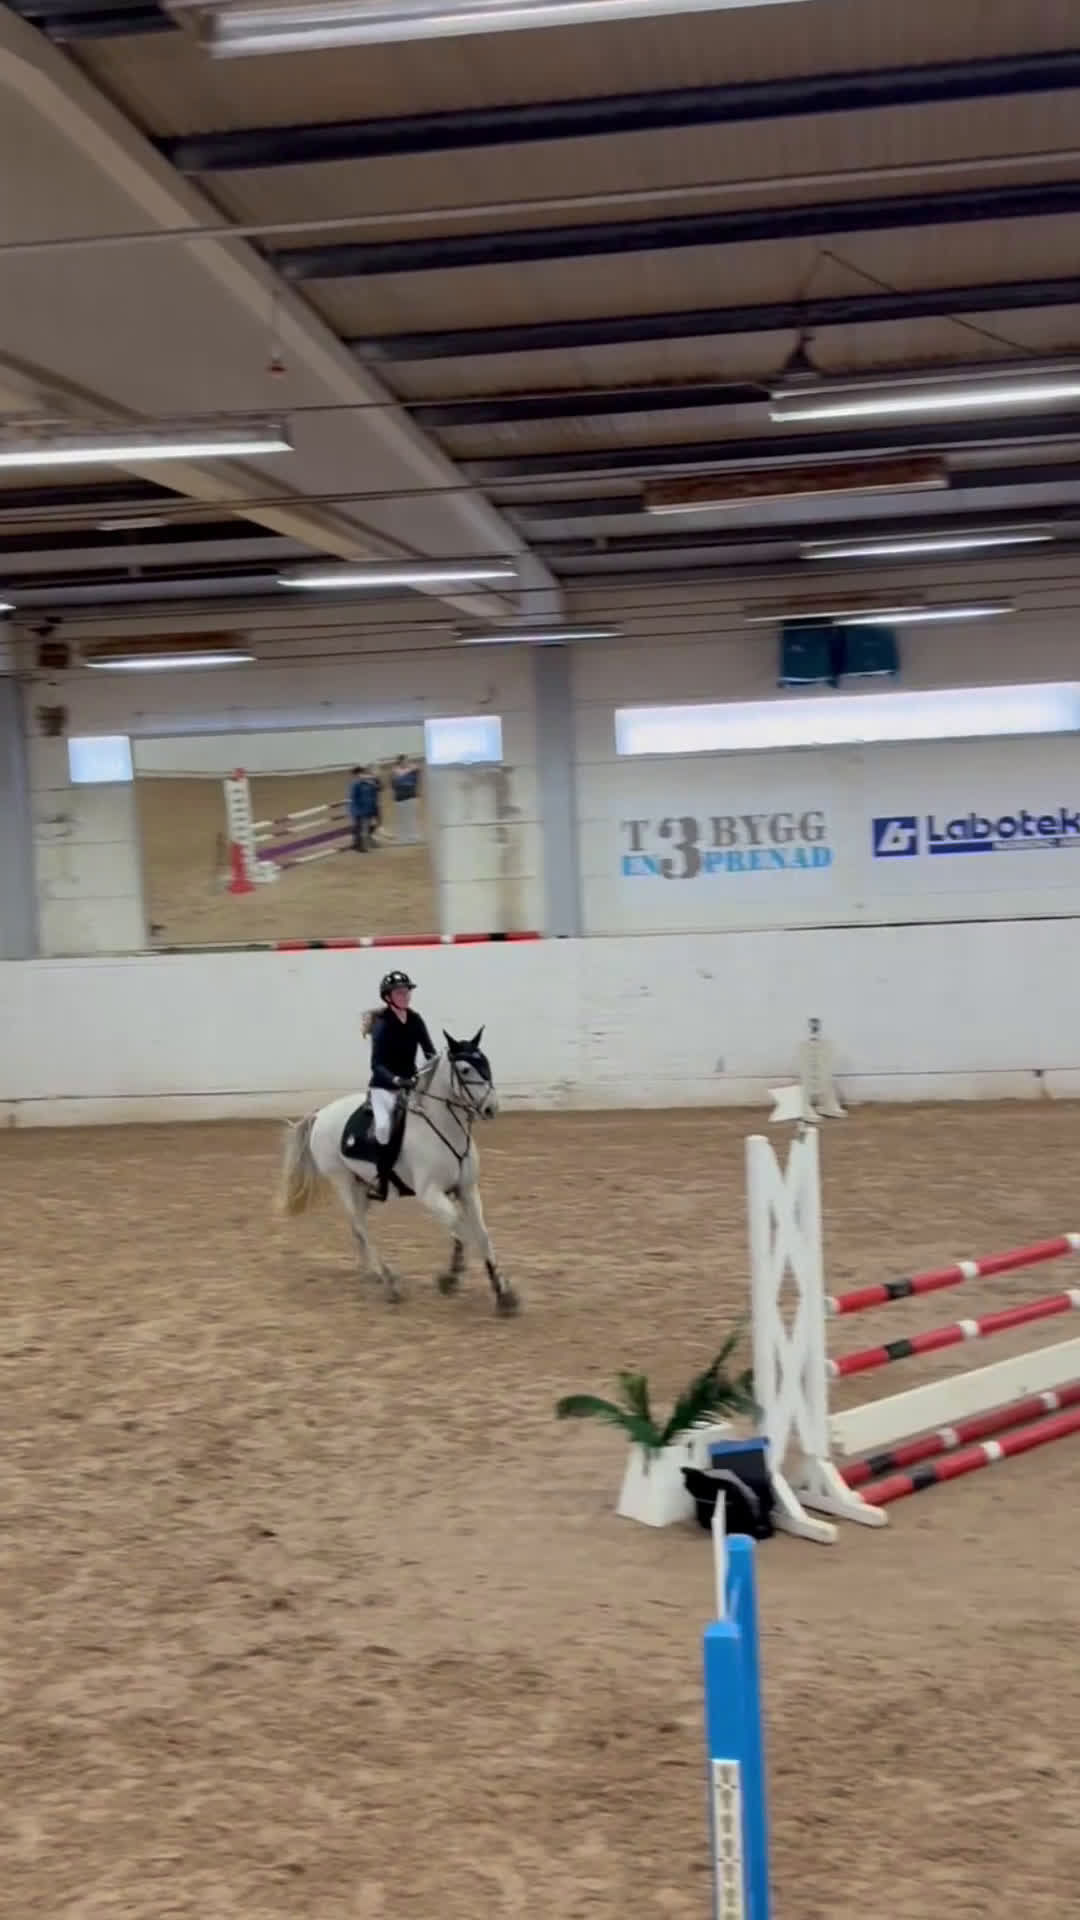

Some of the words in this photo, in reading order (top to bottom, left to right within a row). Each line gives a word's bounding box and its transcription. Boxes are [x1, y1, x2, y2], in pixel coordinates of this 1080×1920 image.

[710, 811, 827, 848] BYGG
[927, 806, 1080, 842] Labotek
[702, 846, 834, 873] PRENAD
